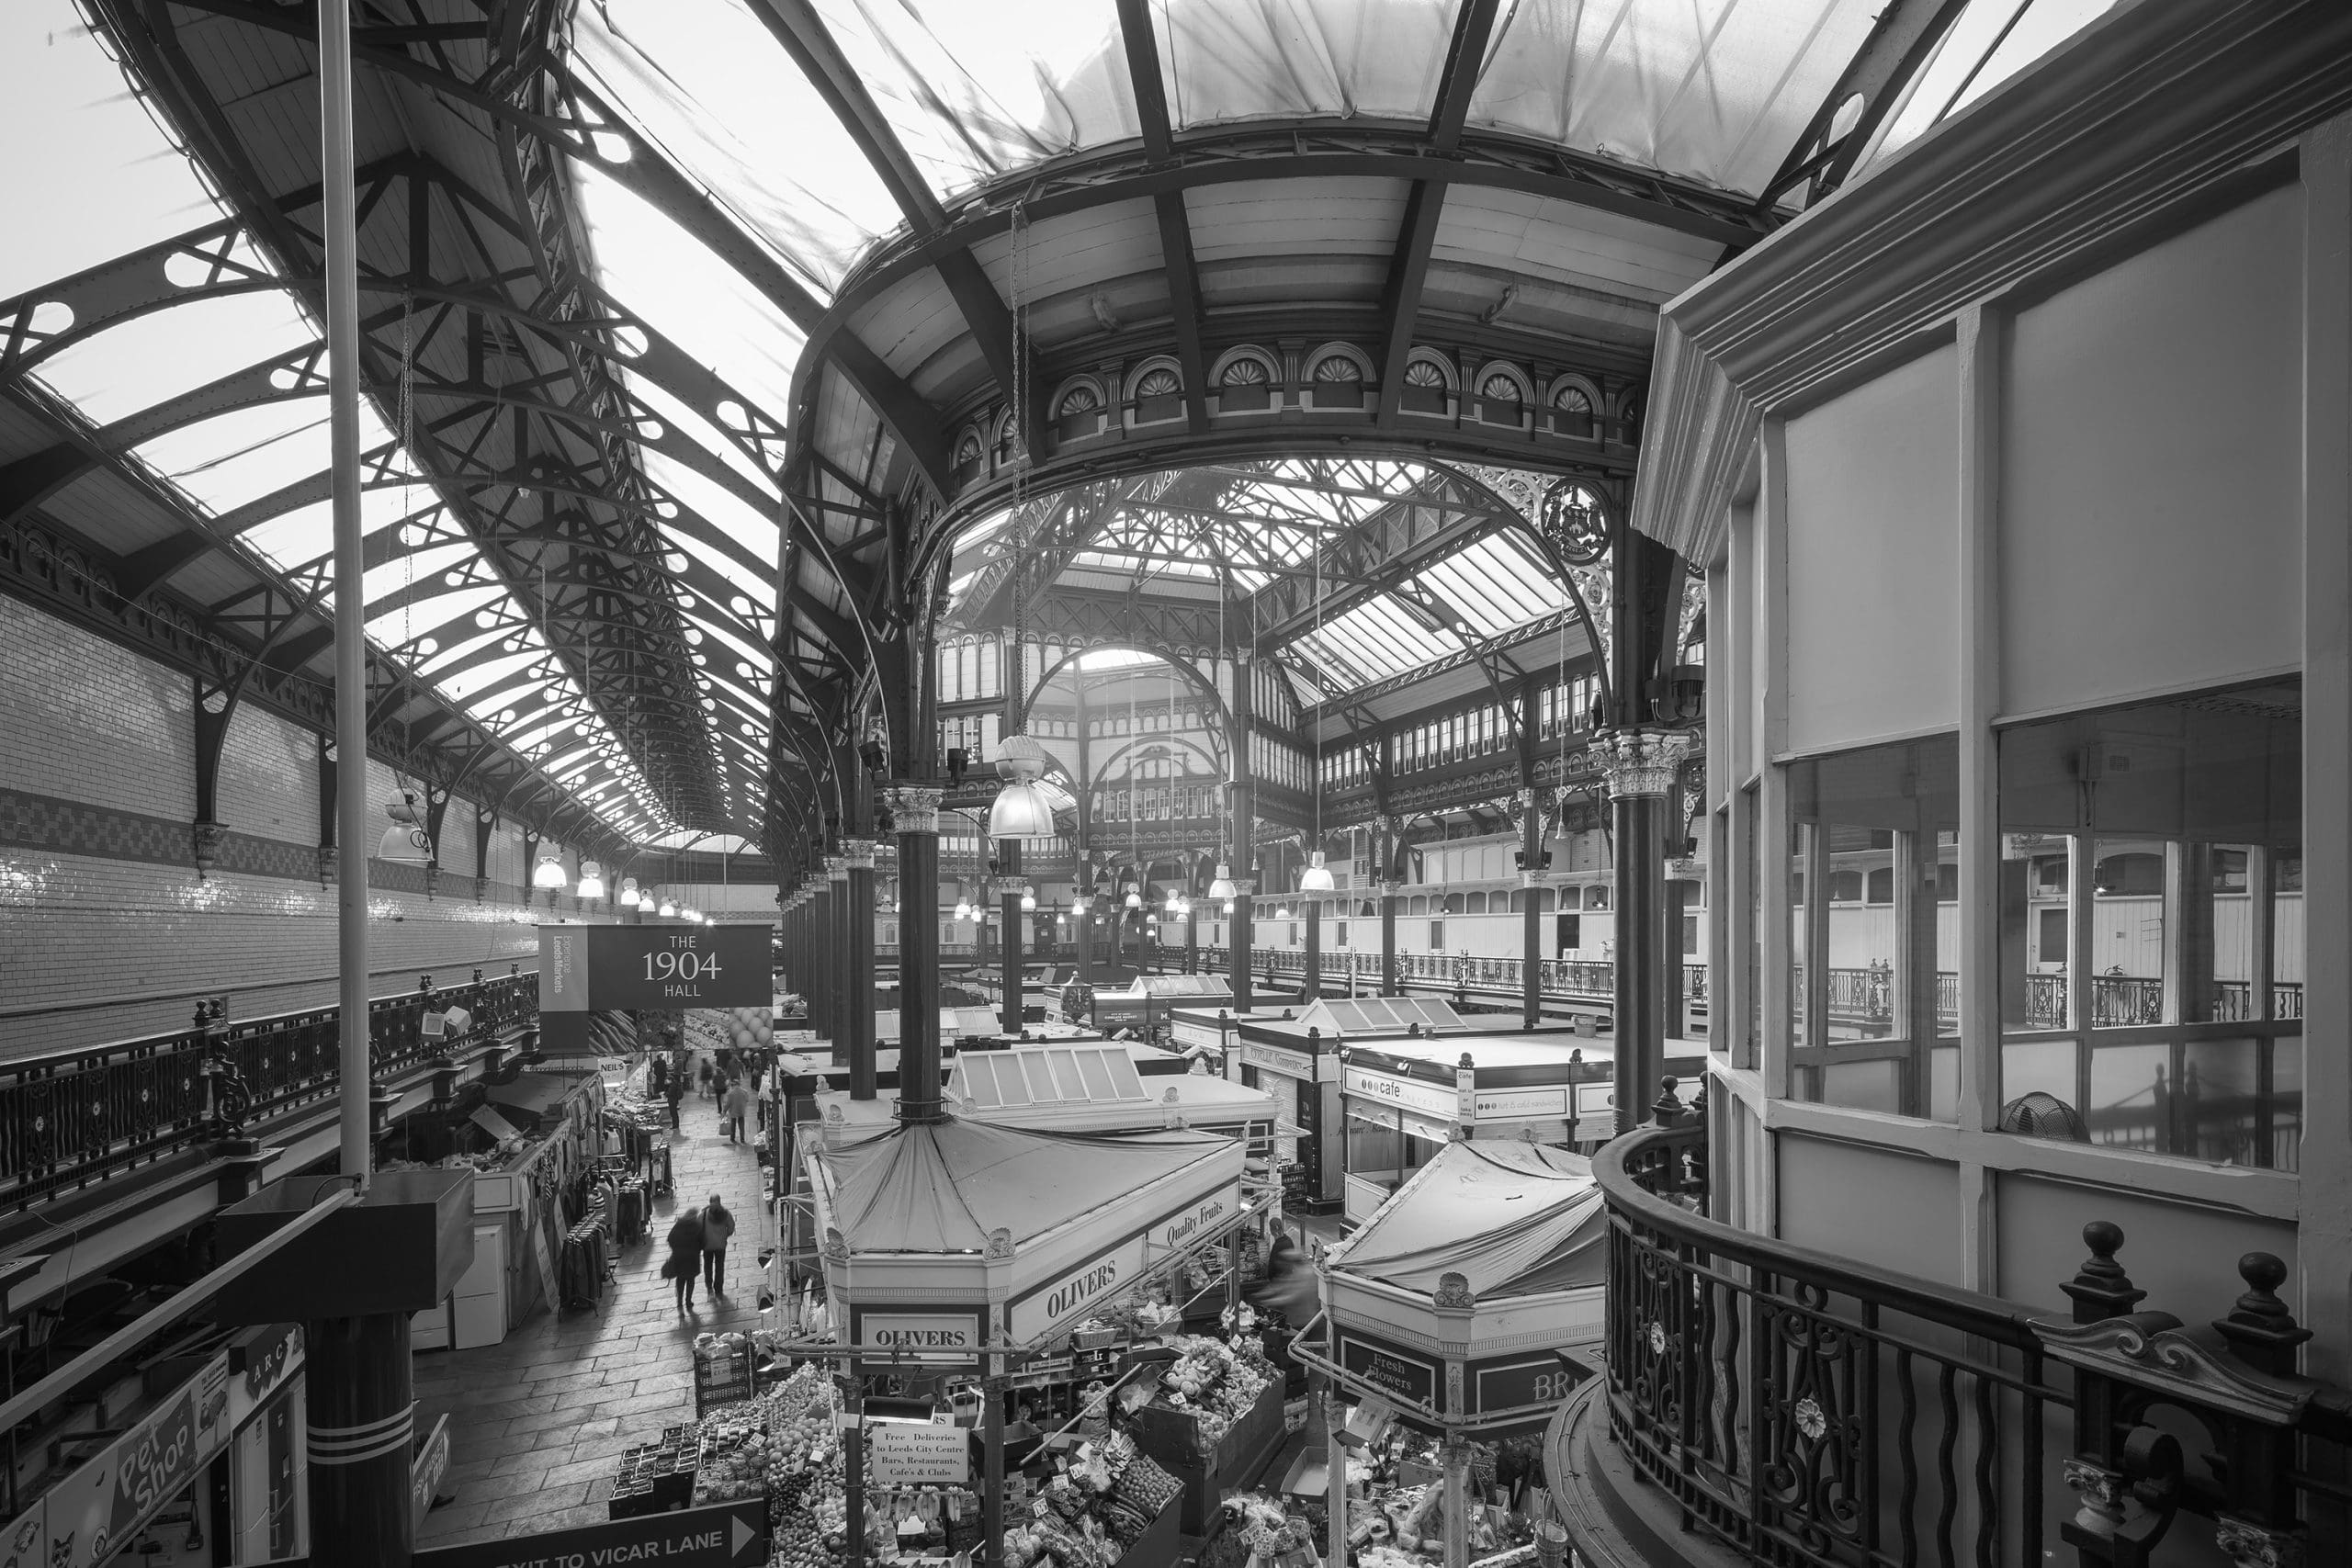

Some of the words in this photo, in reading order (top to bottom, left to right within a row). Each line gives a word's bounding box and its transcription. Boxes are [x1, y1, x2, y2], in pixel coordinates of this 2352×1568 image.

[669, 935, 696, 949] THE
[563, 935, 573, 974] Experience
[643, 951, 722, 981] 1904
[664, 984, 701, 998] HALL
[1380, 1081, 1400, 1097] cafe
[1168, 1216, 1197, 1247] Quality
[1200, 1201, 1224, 1225] Fruits
[1047, 1259, 1116, 1318] OLIVERS
[876, 1329, 967, 1346] OLIVERS
[1374, 1353, 1405, 1374] Fresh
[1368, 1364, 1412, 1391] Flowers
[886, 1433, 906, 1441] Free
[913, 1433, 956, 1441] Deliveries
[888, 1445, 913, 1453] Leeds
[916, 1445, 933, 1455] City
[935, 1445, 965, 1453] Centre
[119, 1424, 160, 1499] Pet
[134, 1425, 188, 1516] Shop
[881, 1456, 904, 1465] Bars,
[907, 1456, 960, 1466] Restaurants,
[889, 1468, 915, 1476] Cafe's
[927, 1468, 952, 1476] Clubs
[555, 1553, 585, 1568] TO
[591, 1541, 660, 1566] VICAR
[666, 1530, 723, 1555] LANE
